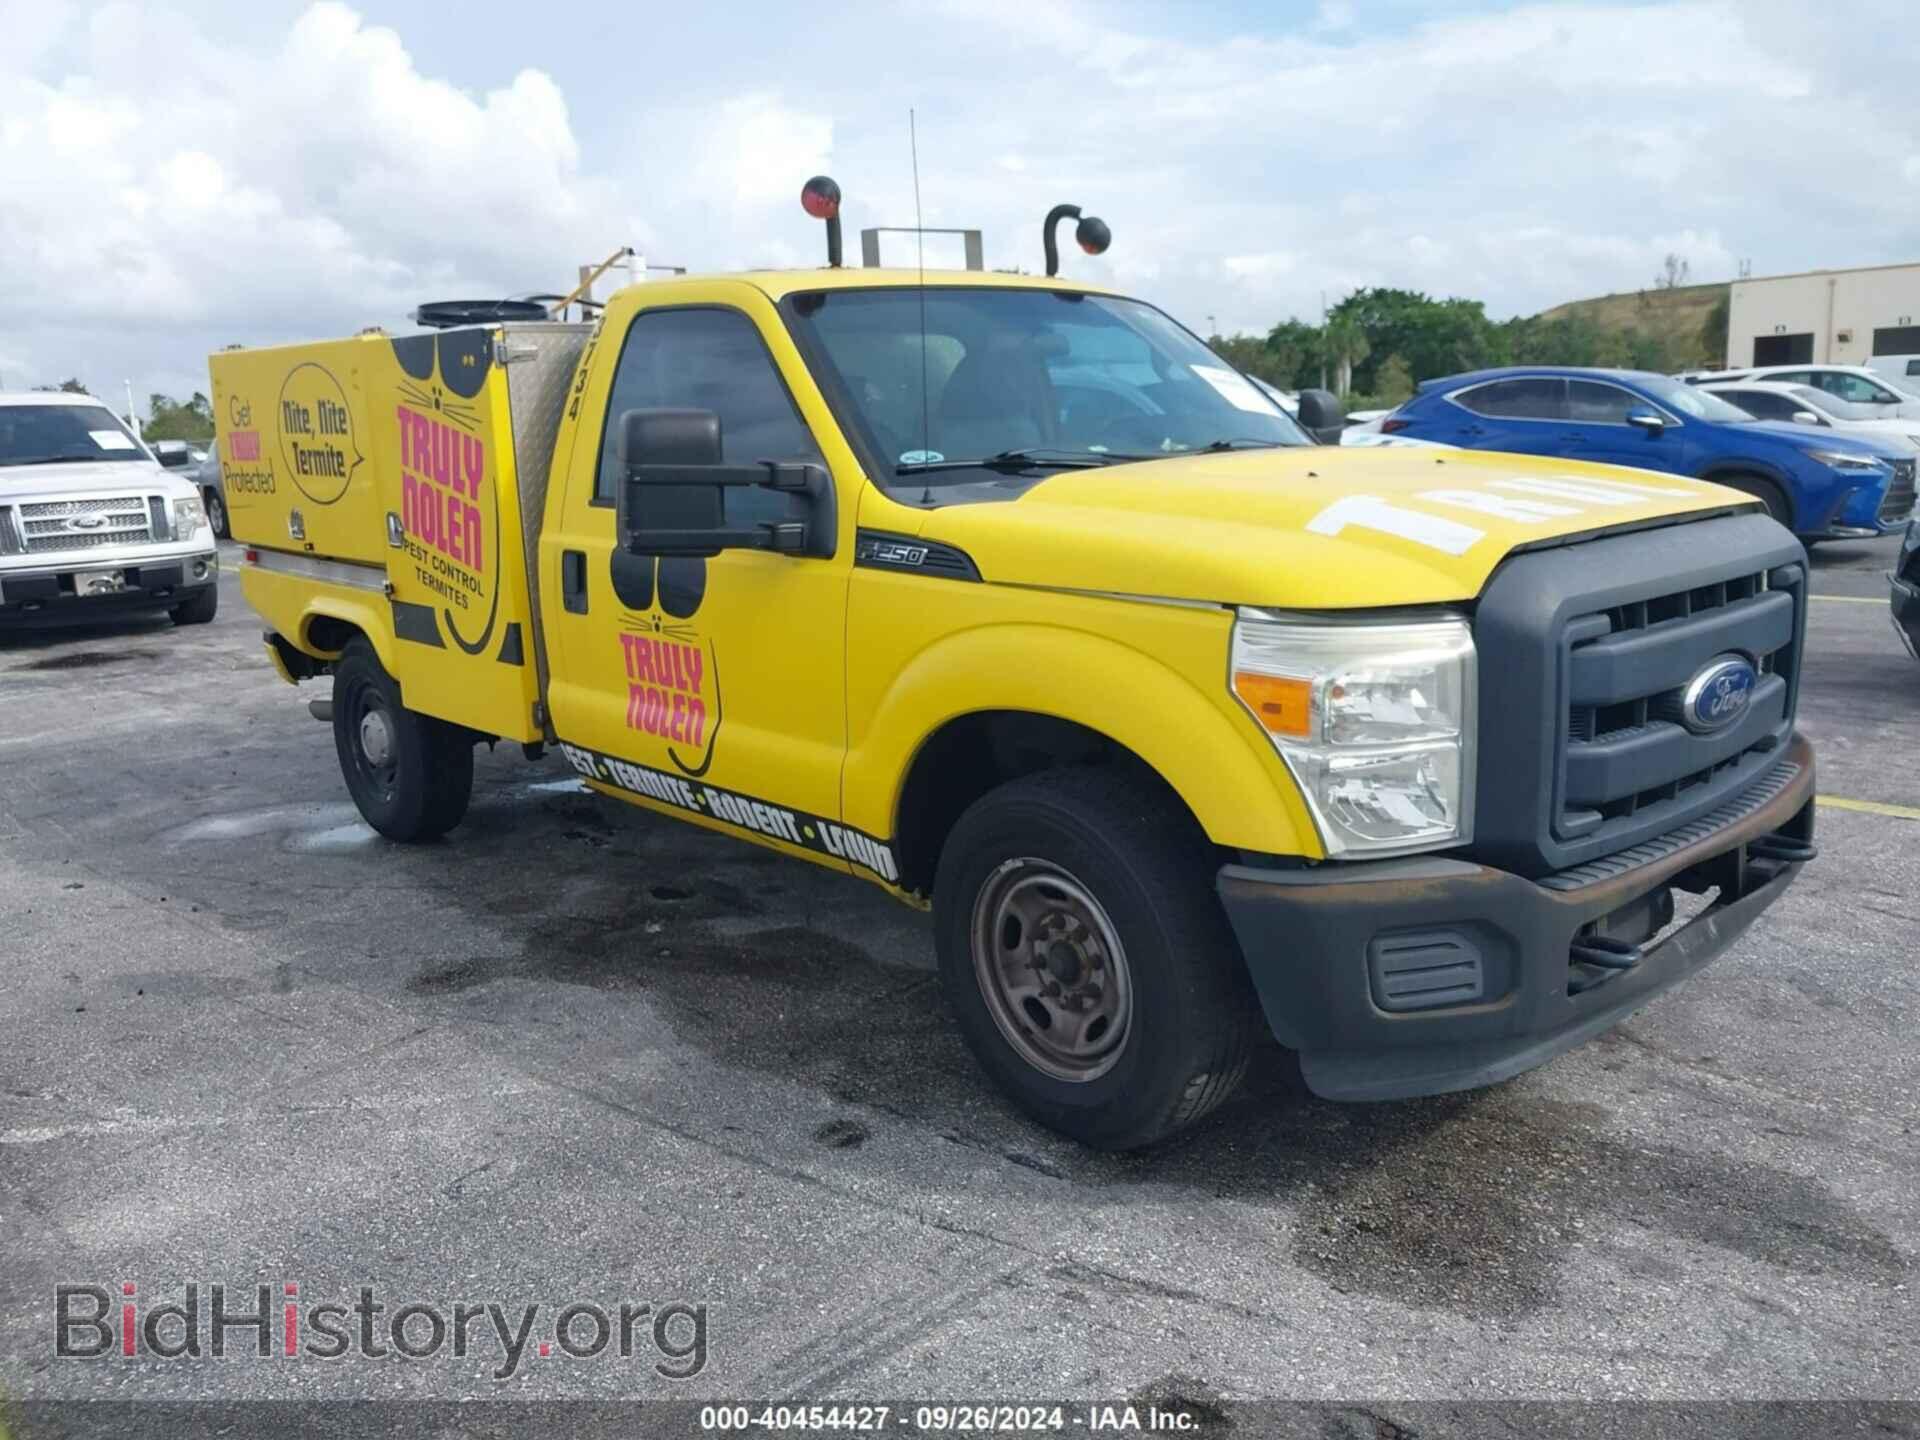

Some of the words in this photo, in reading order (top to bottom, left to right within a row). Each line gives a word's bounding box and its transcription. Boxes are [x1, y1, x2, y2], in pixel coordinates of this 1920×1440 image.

[230, 394, 251, 427] Get
[317, 398, 348, 434] Nite
[292, 441, 346, 477] Termite
[397, 405, 483, 500] TRULY
[401, 472, 482, 572] NOLEN
[402, 538, 428, 562] PEST
[432, 555, 484, 597] CONTROL
[415, 566, 469, 609] TERMITES
[619, 632, 703, 694] TRULY
[626, 682, 705, 747] NOLEN
[603, 756, 700, 811] TERMITE
[703, 786, 803, 844] RODENT
[816, 820, 899, 881] LAWN
